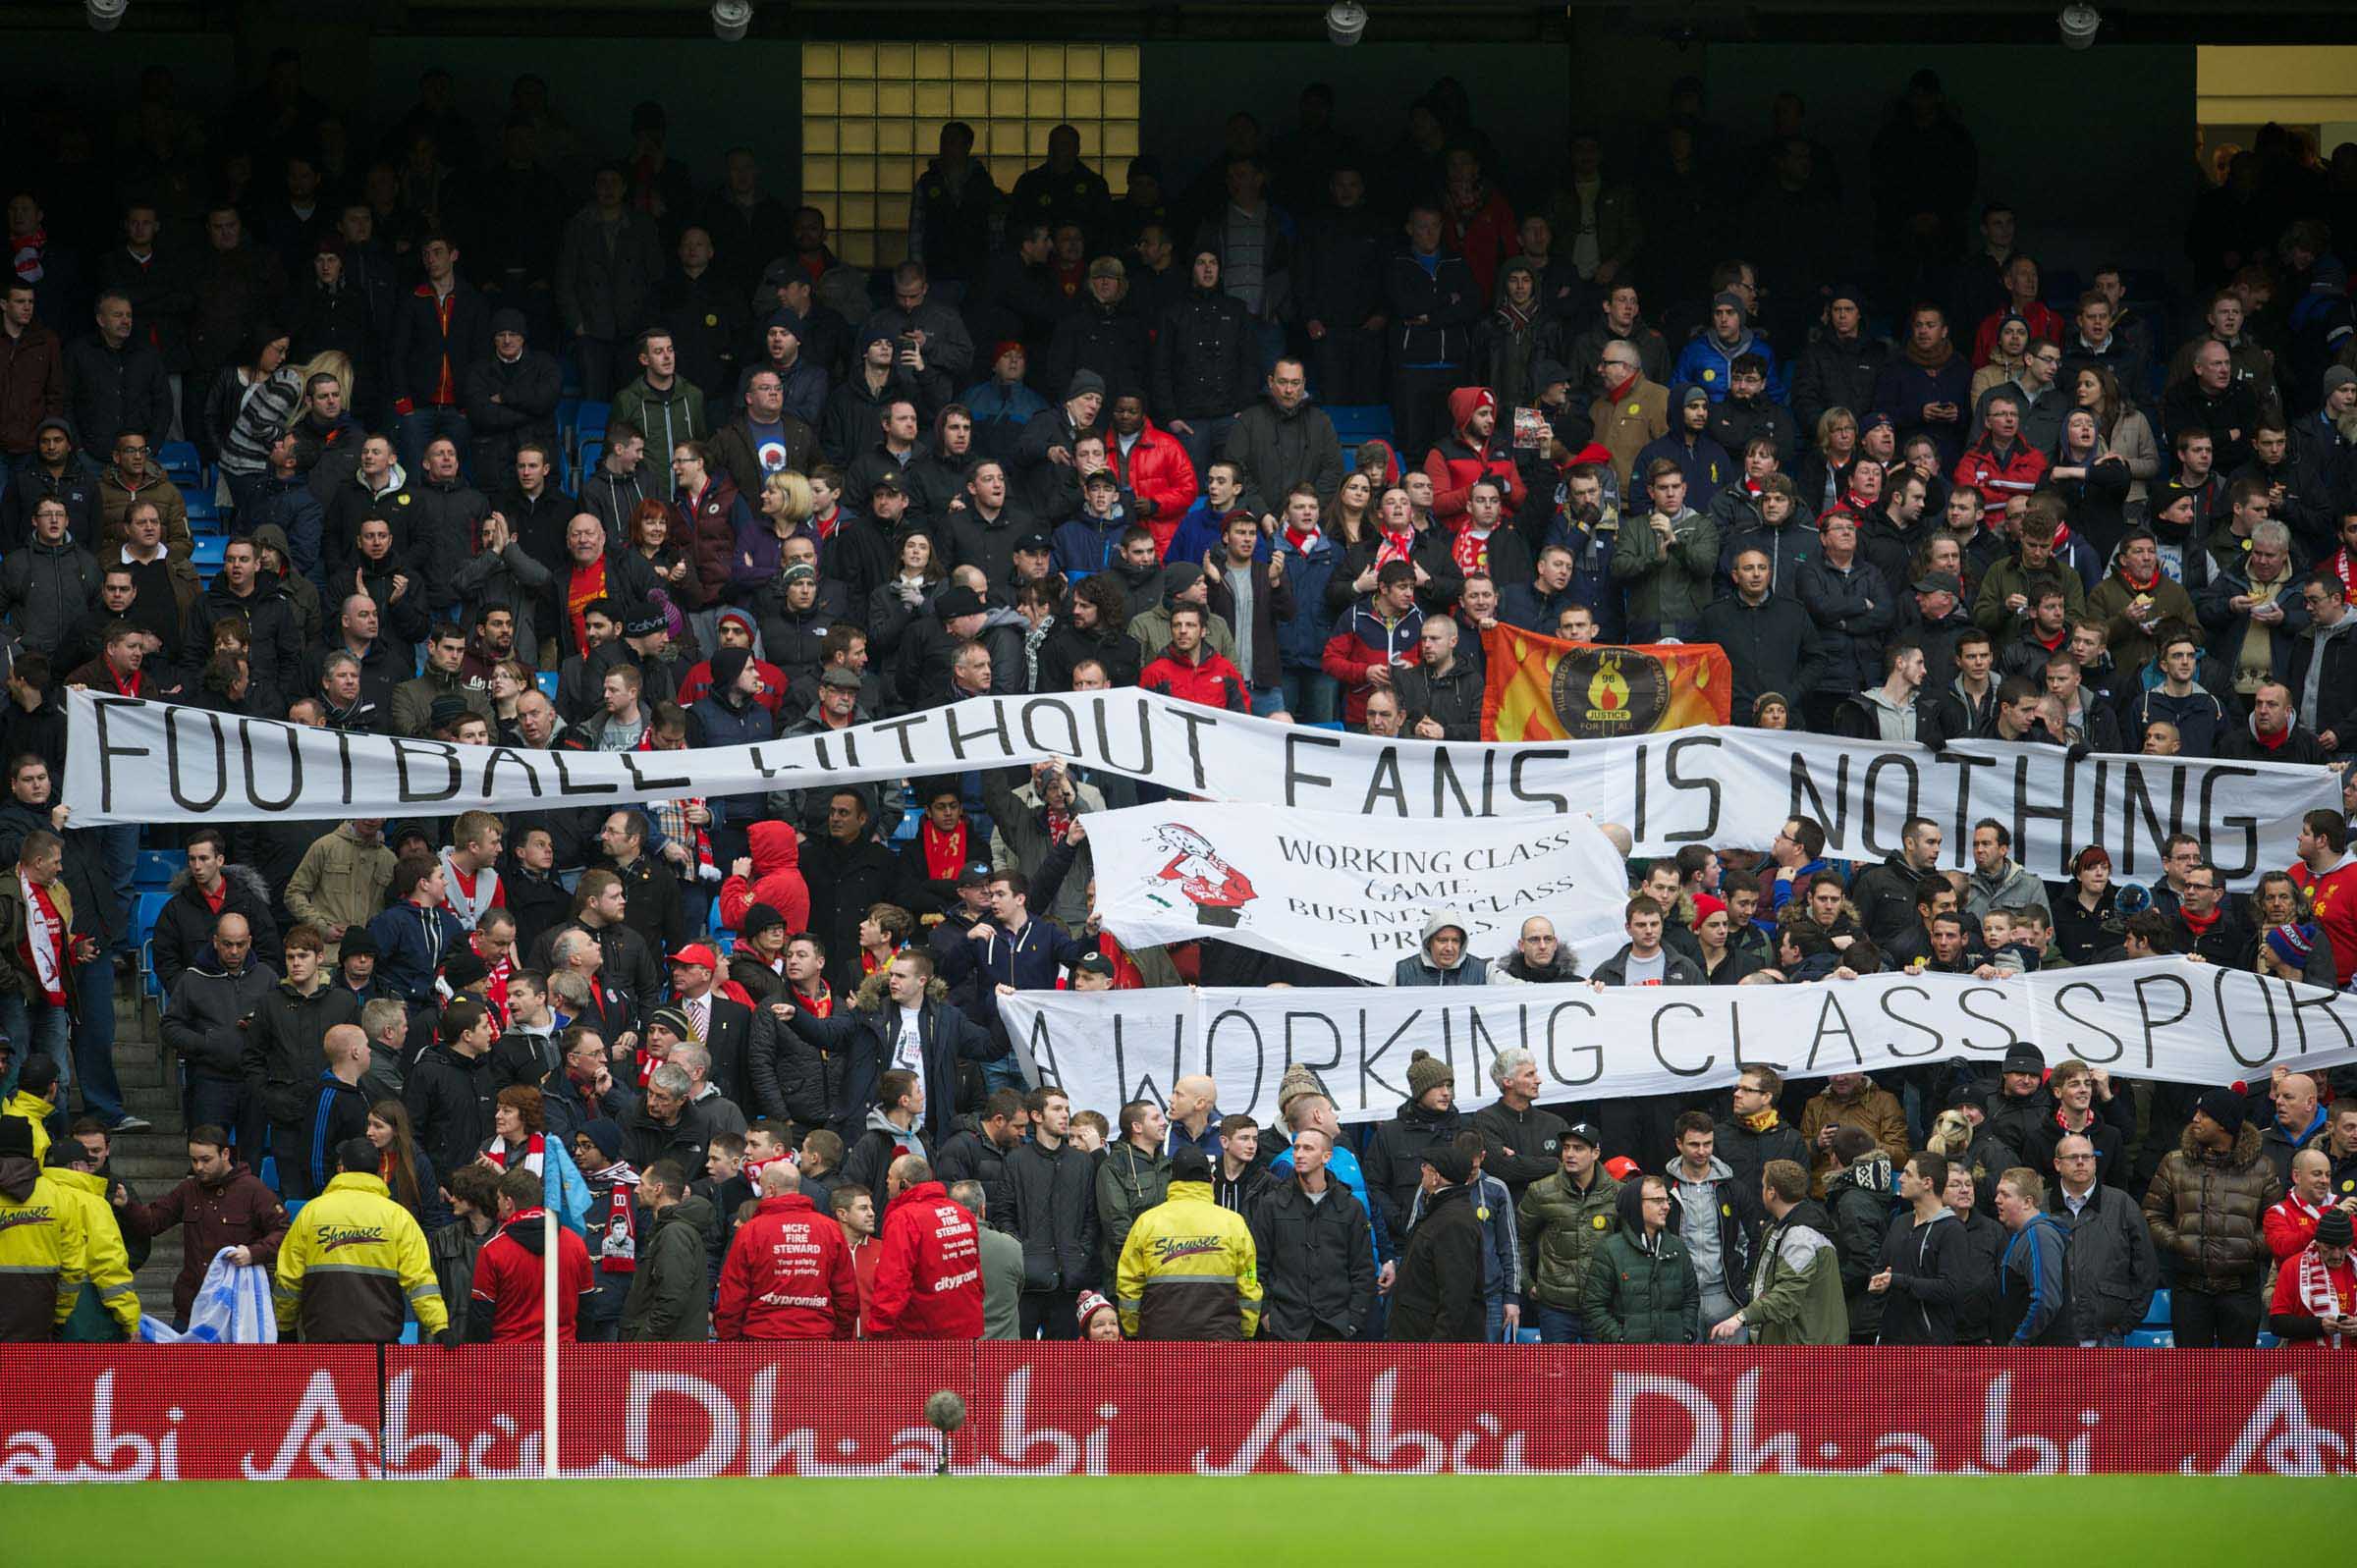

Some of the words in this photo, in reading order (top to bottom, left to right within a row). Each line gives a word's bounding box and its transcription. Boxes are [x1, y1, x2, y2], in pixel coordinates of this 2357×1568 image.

[1602, 675, 1616, 683] 96
[1588, 711, 1628, 720] JUSTICE
[1579, 722, 1600, 730] FOR
[1617, 722, 1635, 730] ALL
[92, 697, 691, 814] FOOTBALL
[1284, 731, 1571, 818] FANS
[1633, 735, 1723, 844] IS
[1789, 750, 2260, 880] NOTHING
[1277, 835, 1453, 875] WORKING
[1462, 831, 1571, 872] CLASS
[1029, 1009, 1064, 1090] A
[1114, 1000, 1605, 1115] WORKING
[1651, 985, 2018, 1076] CLASS
[2053, 968, 2355, 1069] SPOR
[934, 1206, 959, 1217] MCFC
[941, 1215, 960, 1226] FIRE
[782, 1223, 811, 1234] MCFC
[935, 1222, 972, 1239] STEWARD
[786, 1233, 809, 1243] FIRE
[773, 1244, 821, 1255] STEWARD
[1153, 1235, 1220, 1257] Showsec
[603, 1362, 1120, 1480] Dhabi
[1190, 1366, 1528, 1477] Abu
[1591, 1366, 2101, 1477] Dhabi
